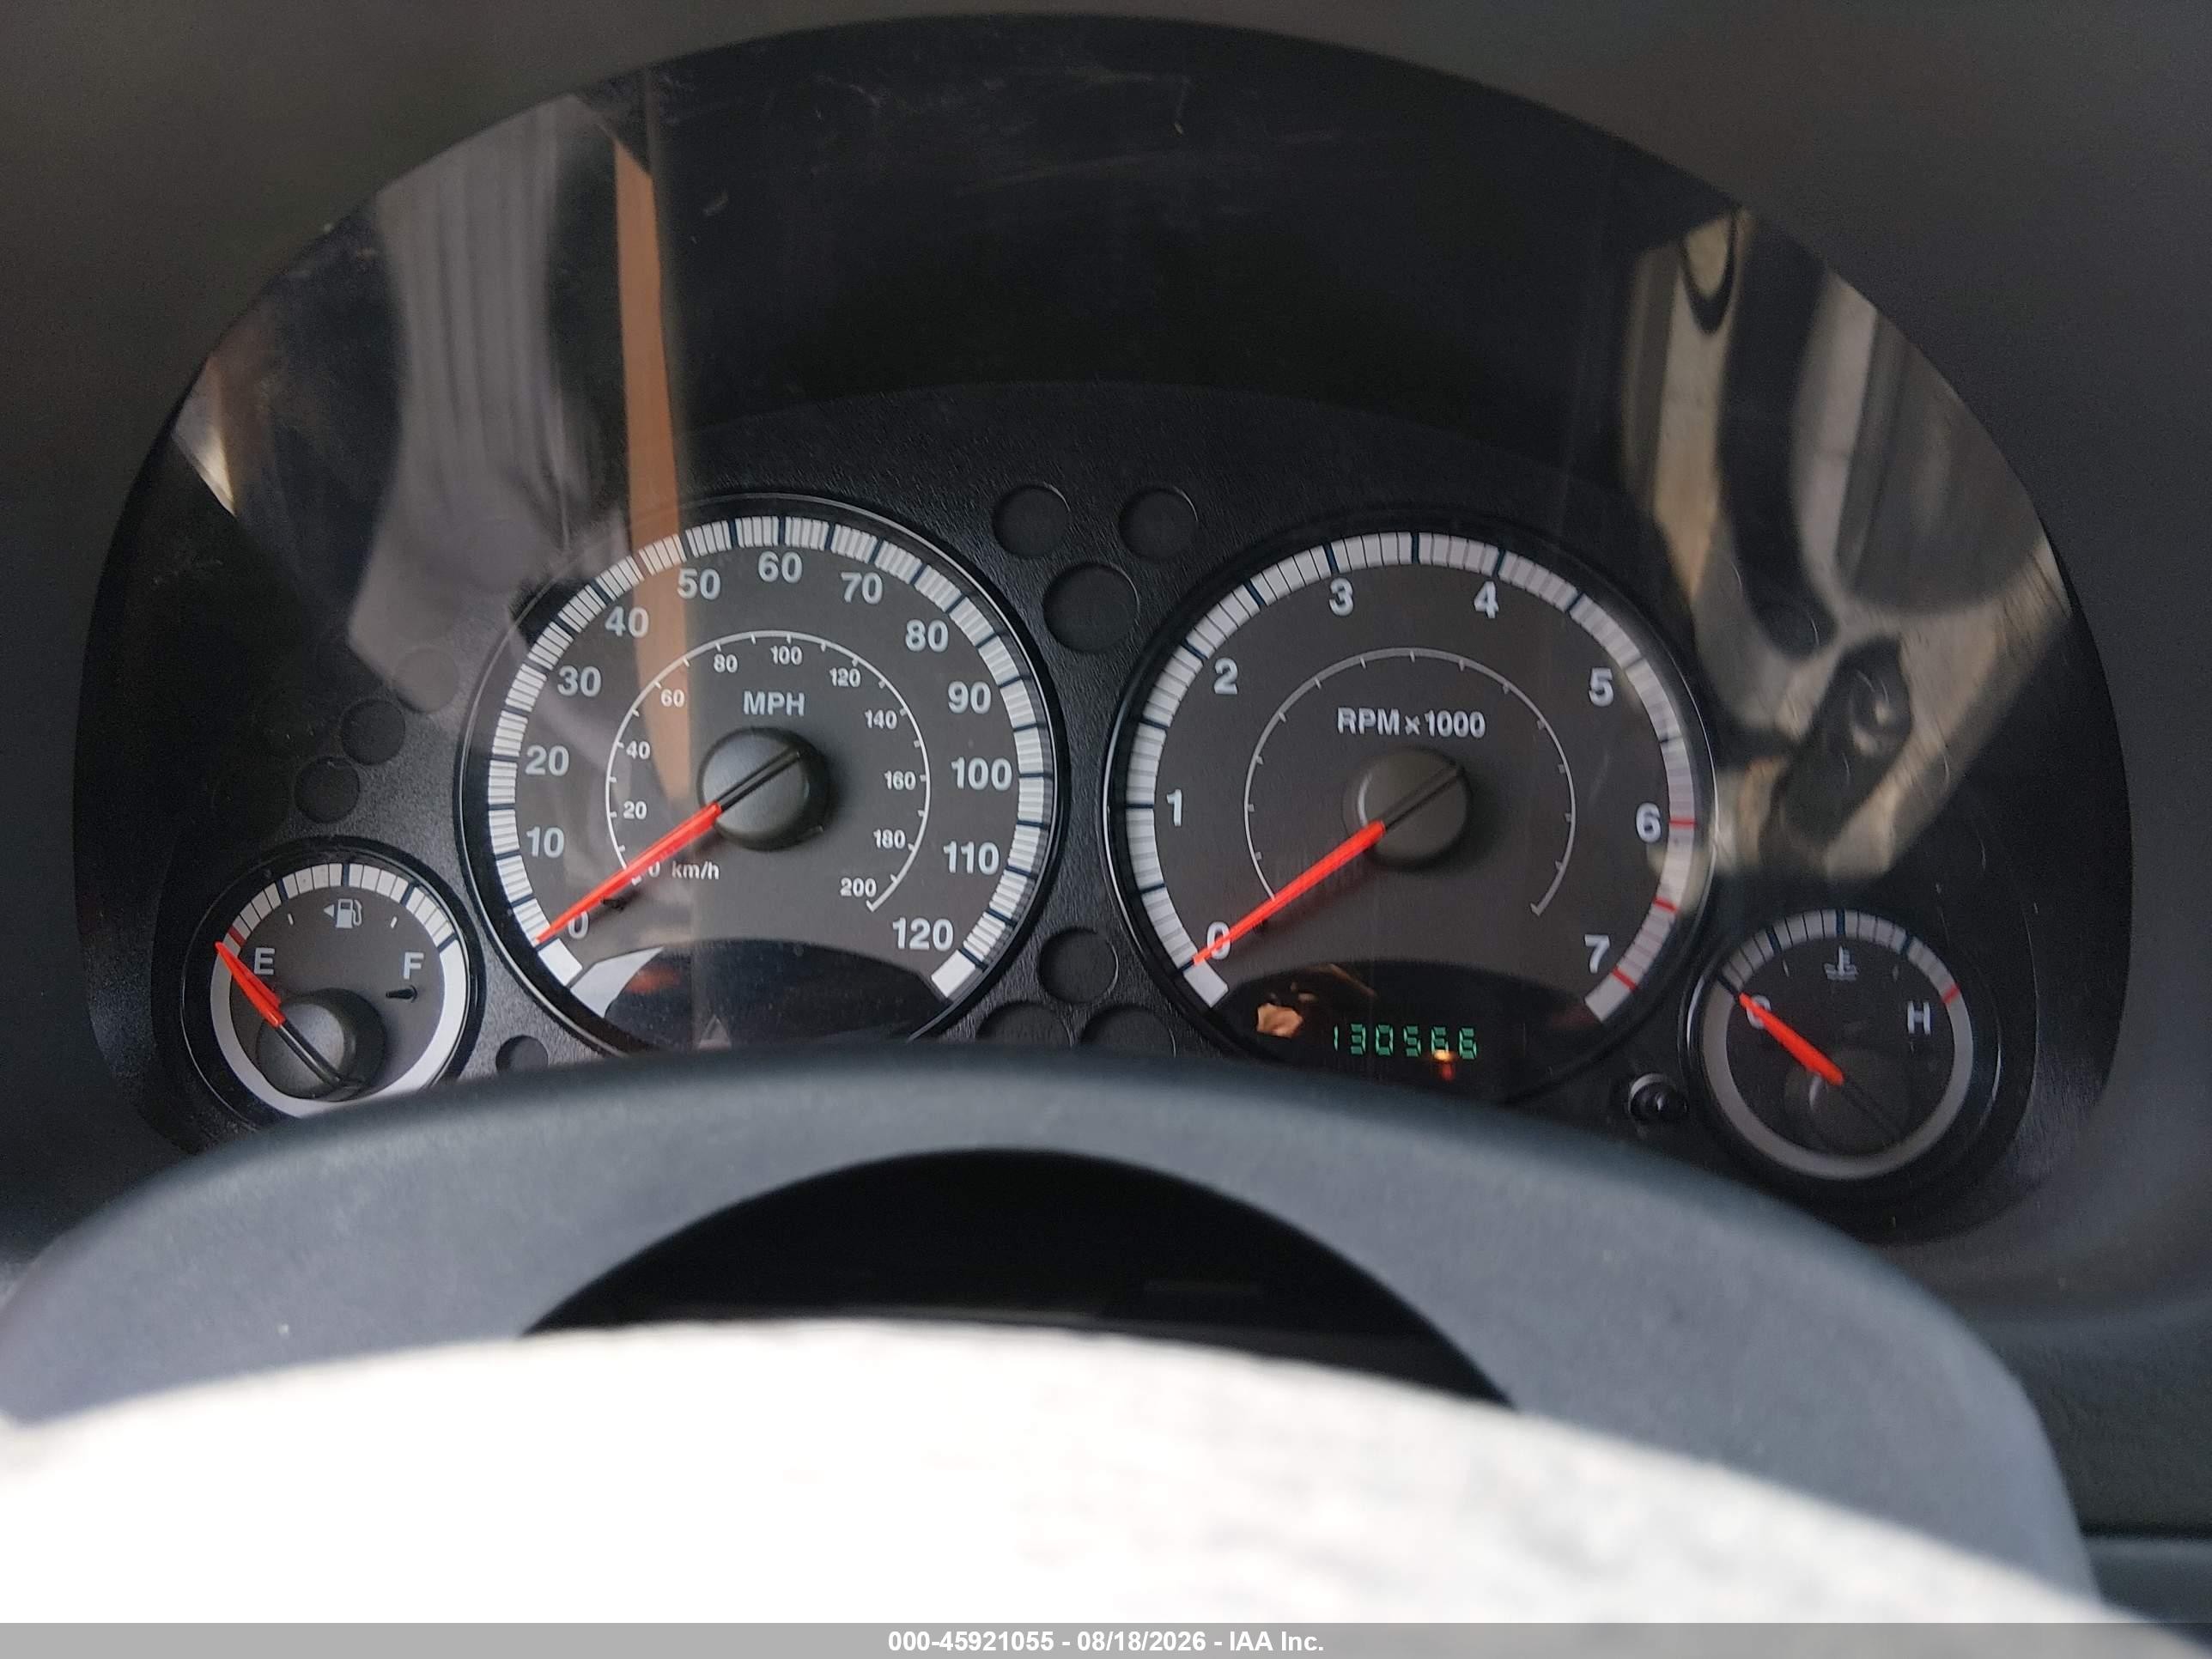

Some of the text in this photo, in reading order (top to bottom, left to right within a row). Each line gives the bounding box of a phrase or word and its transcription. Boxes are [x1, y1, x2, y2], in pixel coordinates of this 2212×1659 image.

[757, 550, 803, 583] 60
[677, 568, 721, 600] 50
[841, 571, 884, 605] 70
[1329, 578, 1354, 617] 3
[1474, 580, 1499, 619] 4
[605, 605, 650, 638] 40
[905, 619, 949, 653] 80
[713, 653, 738, 673] 80
[770, 645, 803, 665] 100
[557, 665, 602, 697] 30
[829, 666, 861, 688] 120
[1213, 658, 1238, 696] 2
[1589, 667, 1613, 707] 5
[660, 689, 685, 708] 60
[743, 690, 805, 716] MPH
[947, 681, 991, 714] 90
[864, 709, 897, 730] 140
[525, 744, 570, 776] 20
[626, 740, 651, 760] 40
[884, 769, 916, 790] 160
[951, 757, 1012, 791] 100
[623, 800, 647, 820] 20
[1166, 788, 1183, 827] 1
[1635, 802, 1662, 842] 6
[526, 826, 565, 859] 10
[872, 829, 906, 849] 180
[671, 860, 720, 879] km/h
[943, 841, 1000, 875] 110
[839, 877, 877, 897] 200
[892, 917, 954, 951] 120
[253, 947, 276, 975] E
[403, 951, 424, 980] F
[1583, 933, 1611, 973] 7
[1907, 1000, 1931, 1035] H
[1333, 1024, 1478, 1060] 130566
